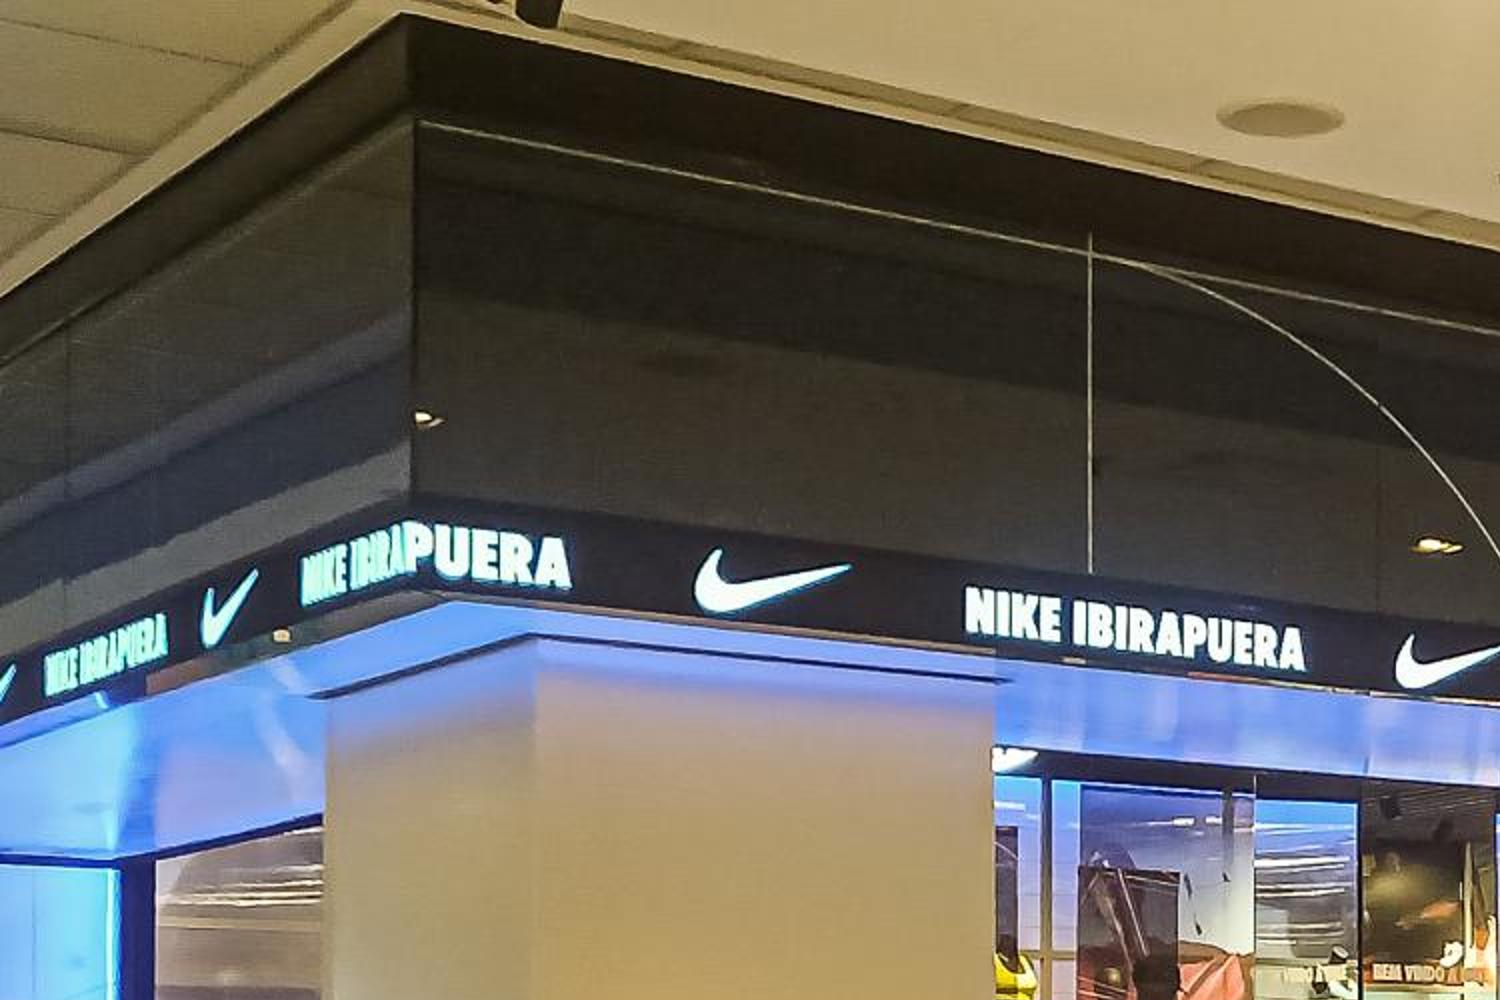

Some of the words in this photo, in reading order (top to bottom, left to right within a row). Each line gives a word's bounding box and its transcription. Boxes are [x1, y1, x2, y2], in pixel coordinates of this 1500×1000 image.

[302, 543, 347, 607] NIKE
[350, 520, 573, 591] IBIRAPUERA
[964, 586, 1062, 642] NIKE
[1073, 600, 1307, 671] IBIRAPUERA
